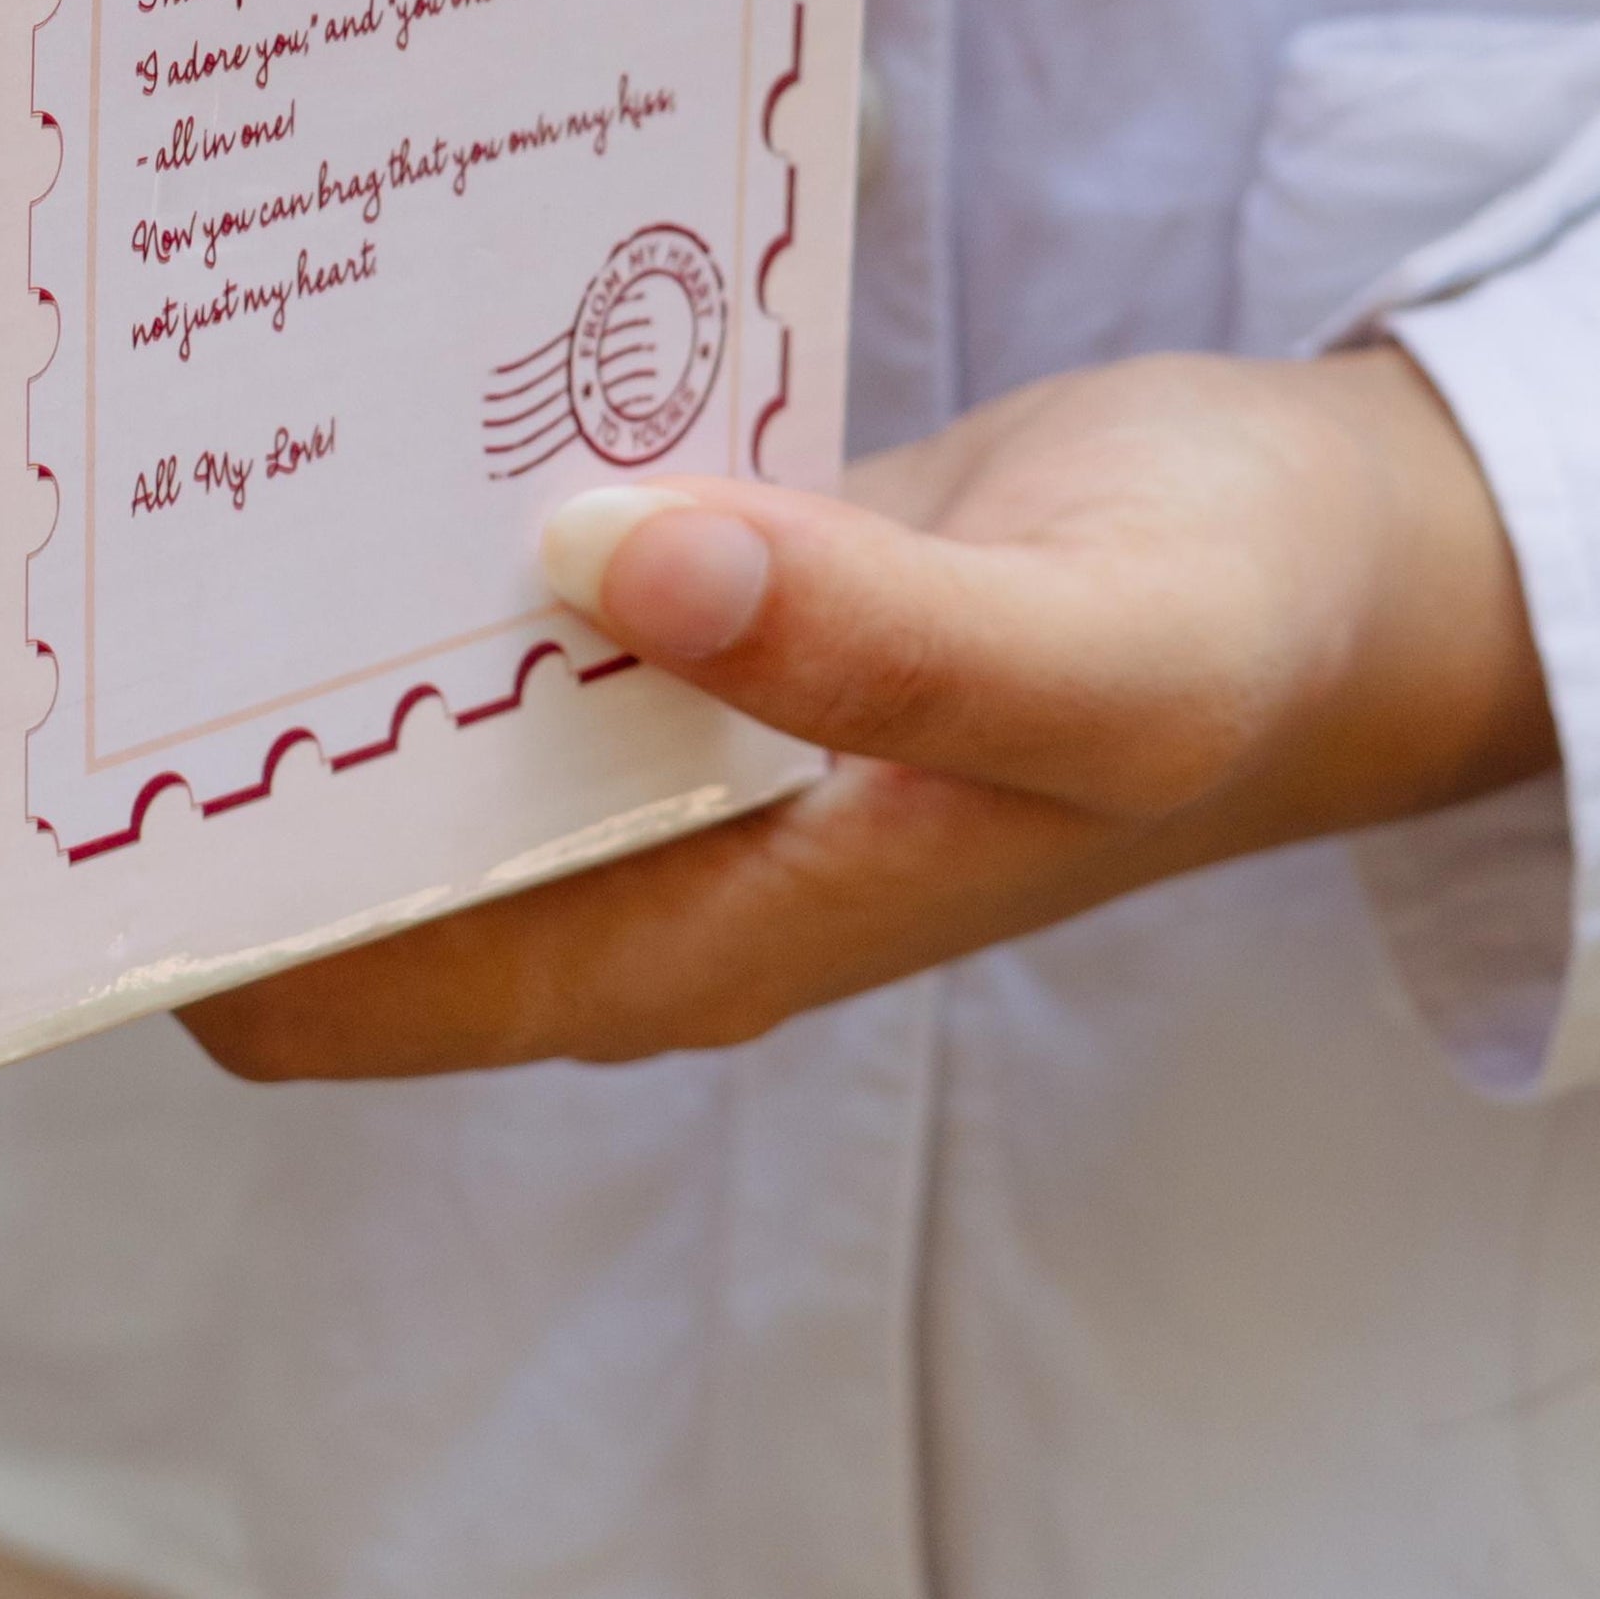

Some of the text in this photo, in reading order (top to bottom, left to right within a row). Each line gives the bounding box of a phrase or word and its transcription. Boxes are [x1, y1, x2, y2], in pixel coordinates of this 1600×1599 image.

[167, 40, 251, 87] adore
[255, 13, 319, 89] you,"
[155, 115, 198, 173] all
[203, 128, 237, 162] in
[241, 98, 295, 148] one!
[131, 210, 197, 264] Now
[203, 208, 257, 269] you
[259, 191, 314, 227] can
[318, 160, 385, 224] brag
[388, 136, 448, 189] that
[453, 137, 503, 197] you
[508, 112, 563, 154] own
[567, 106, 614, 156] my
[132, 296, 179, 350] not
[178, 278, 240, 362] just
[243, 280, 294, 332] my
[578, 243, 714, 359] FROM MY HEART
[131, 416, 336, 518] All My Love!
